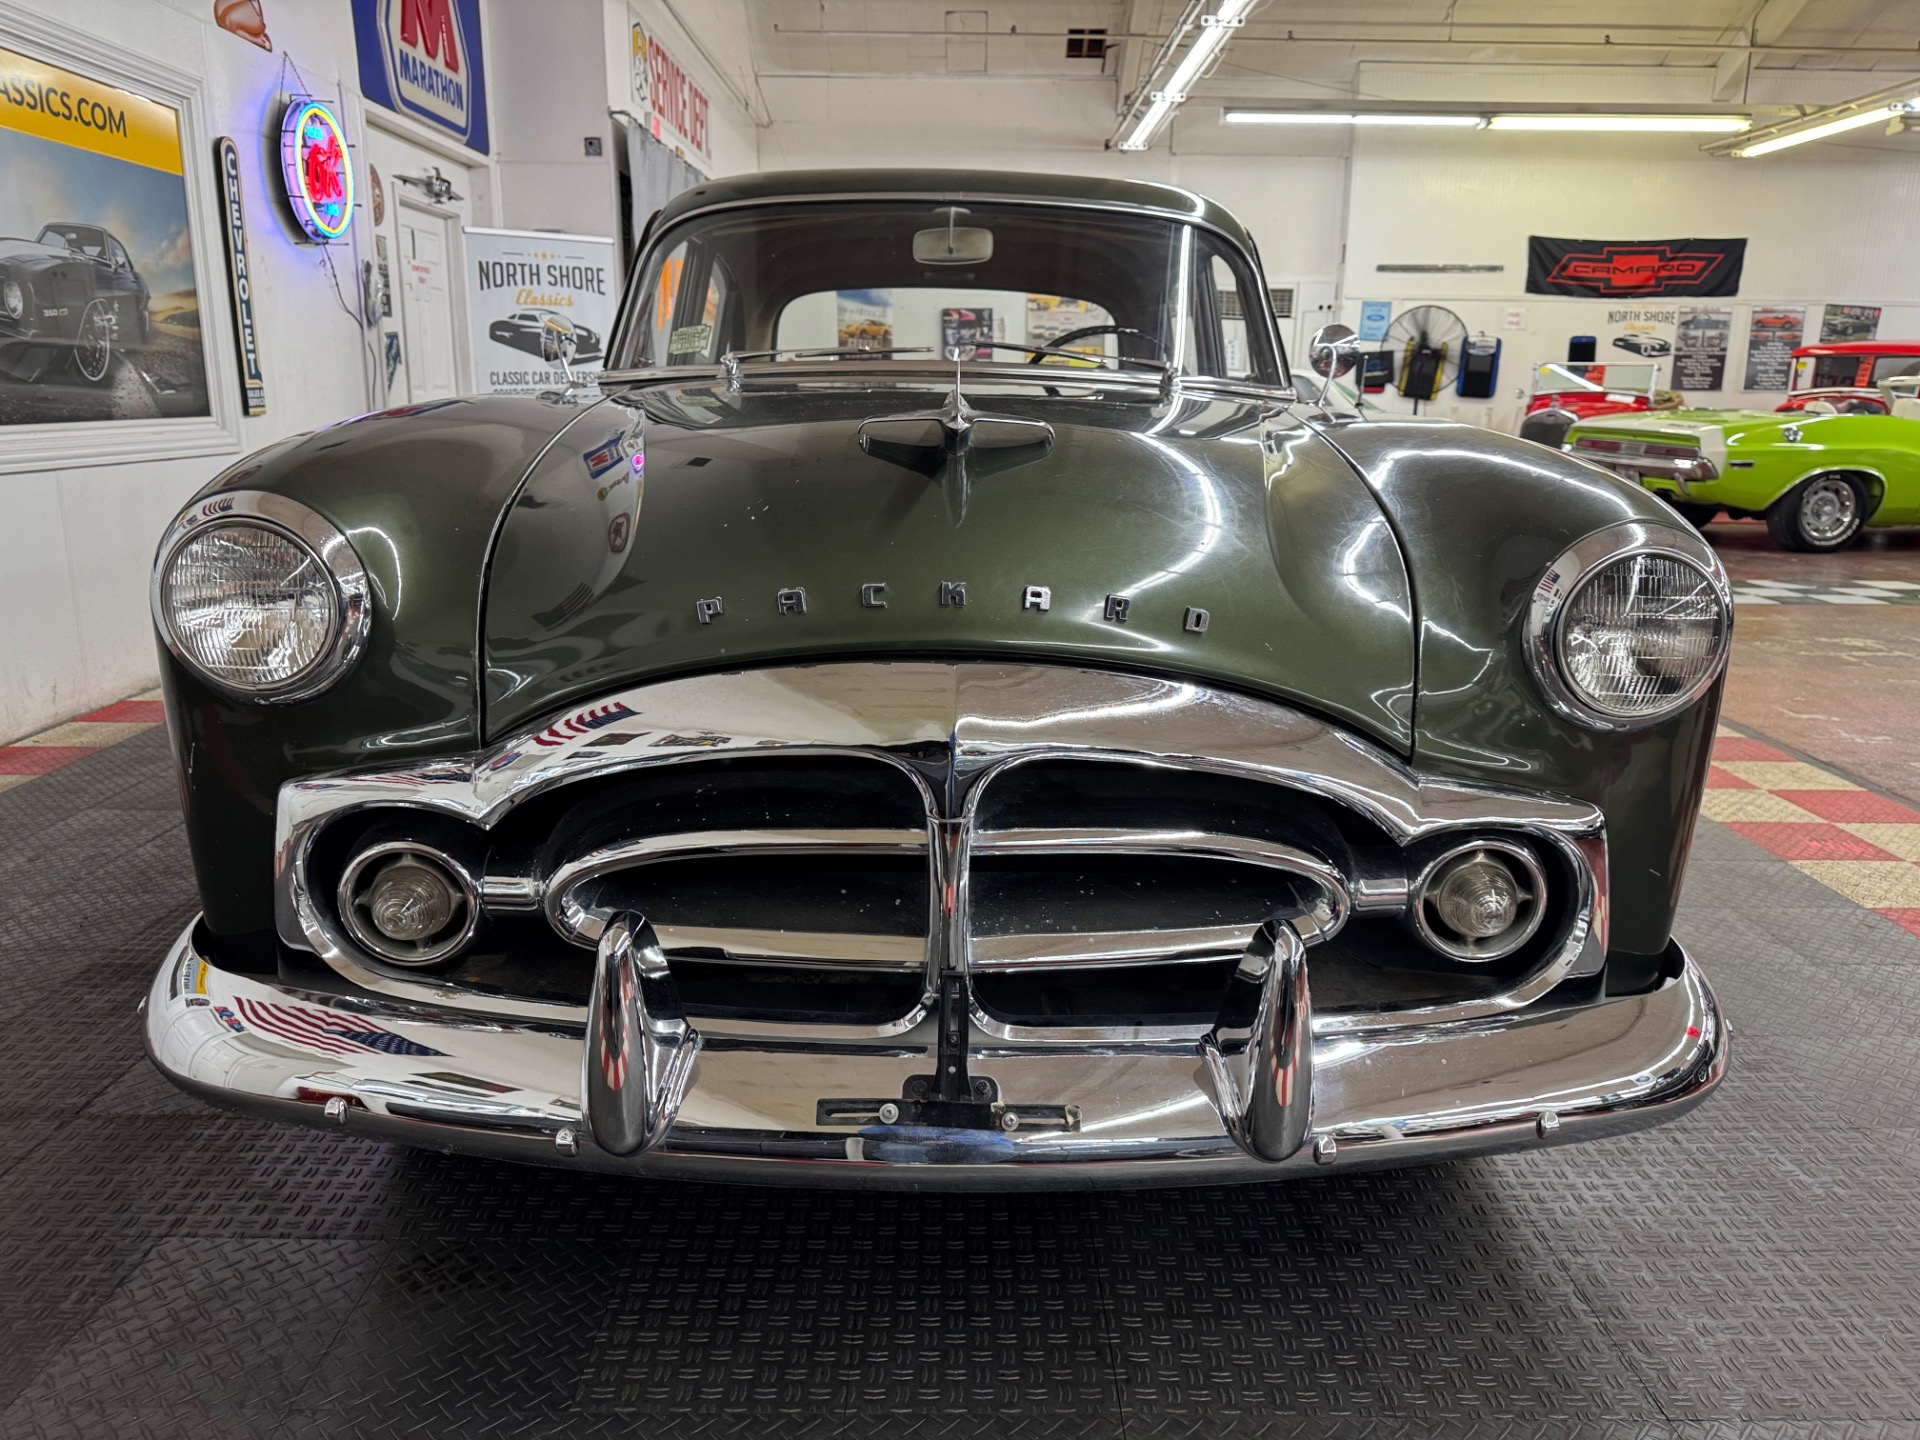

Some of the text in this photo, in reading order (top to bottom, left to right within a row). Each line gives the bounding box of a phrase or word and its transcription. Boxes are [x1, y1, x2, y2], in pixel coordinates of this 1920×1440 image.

[398, 48, 464, 112] MARATHON
[226, 151, 256, 375] CHEVROLET
[1572, 262, 1696, 276] CAMARO
[478, 260, 606, 296] NORTH SHORE
[516, 288, 575, 307] Classics
[1607, 310, 1676, 325] NORTH SHORE
[490, 371, 530, 386] CLASSIC
[532, 371, 552, 385] CAR
[696, 580, 1211, 633] PACKARD
